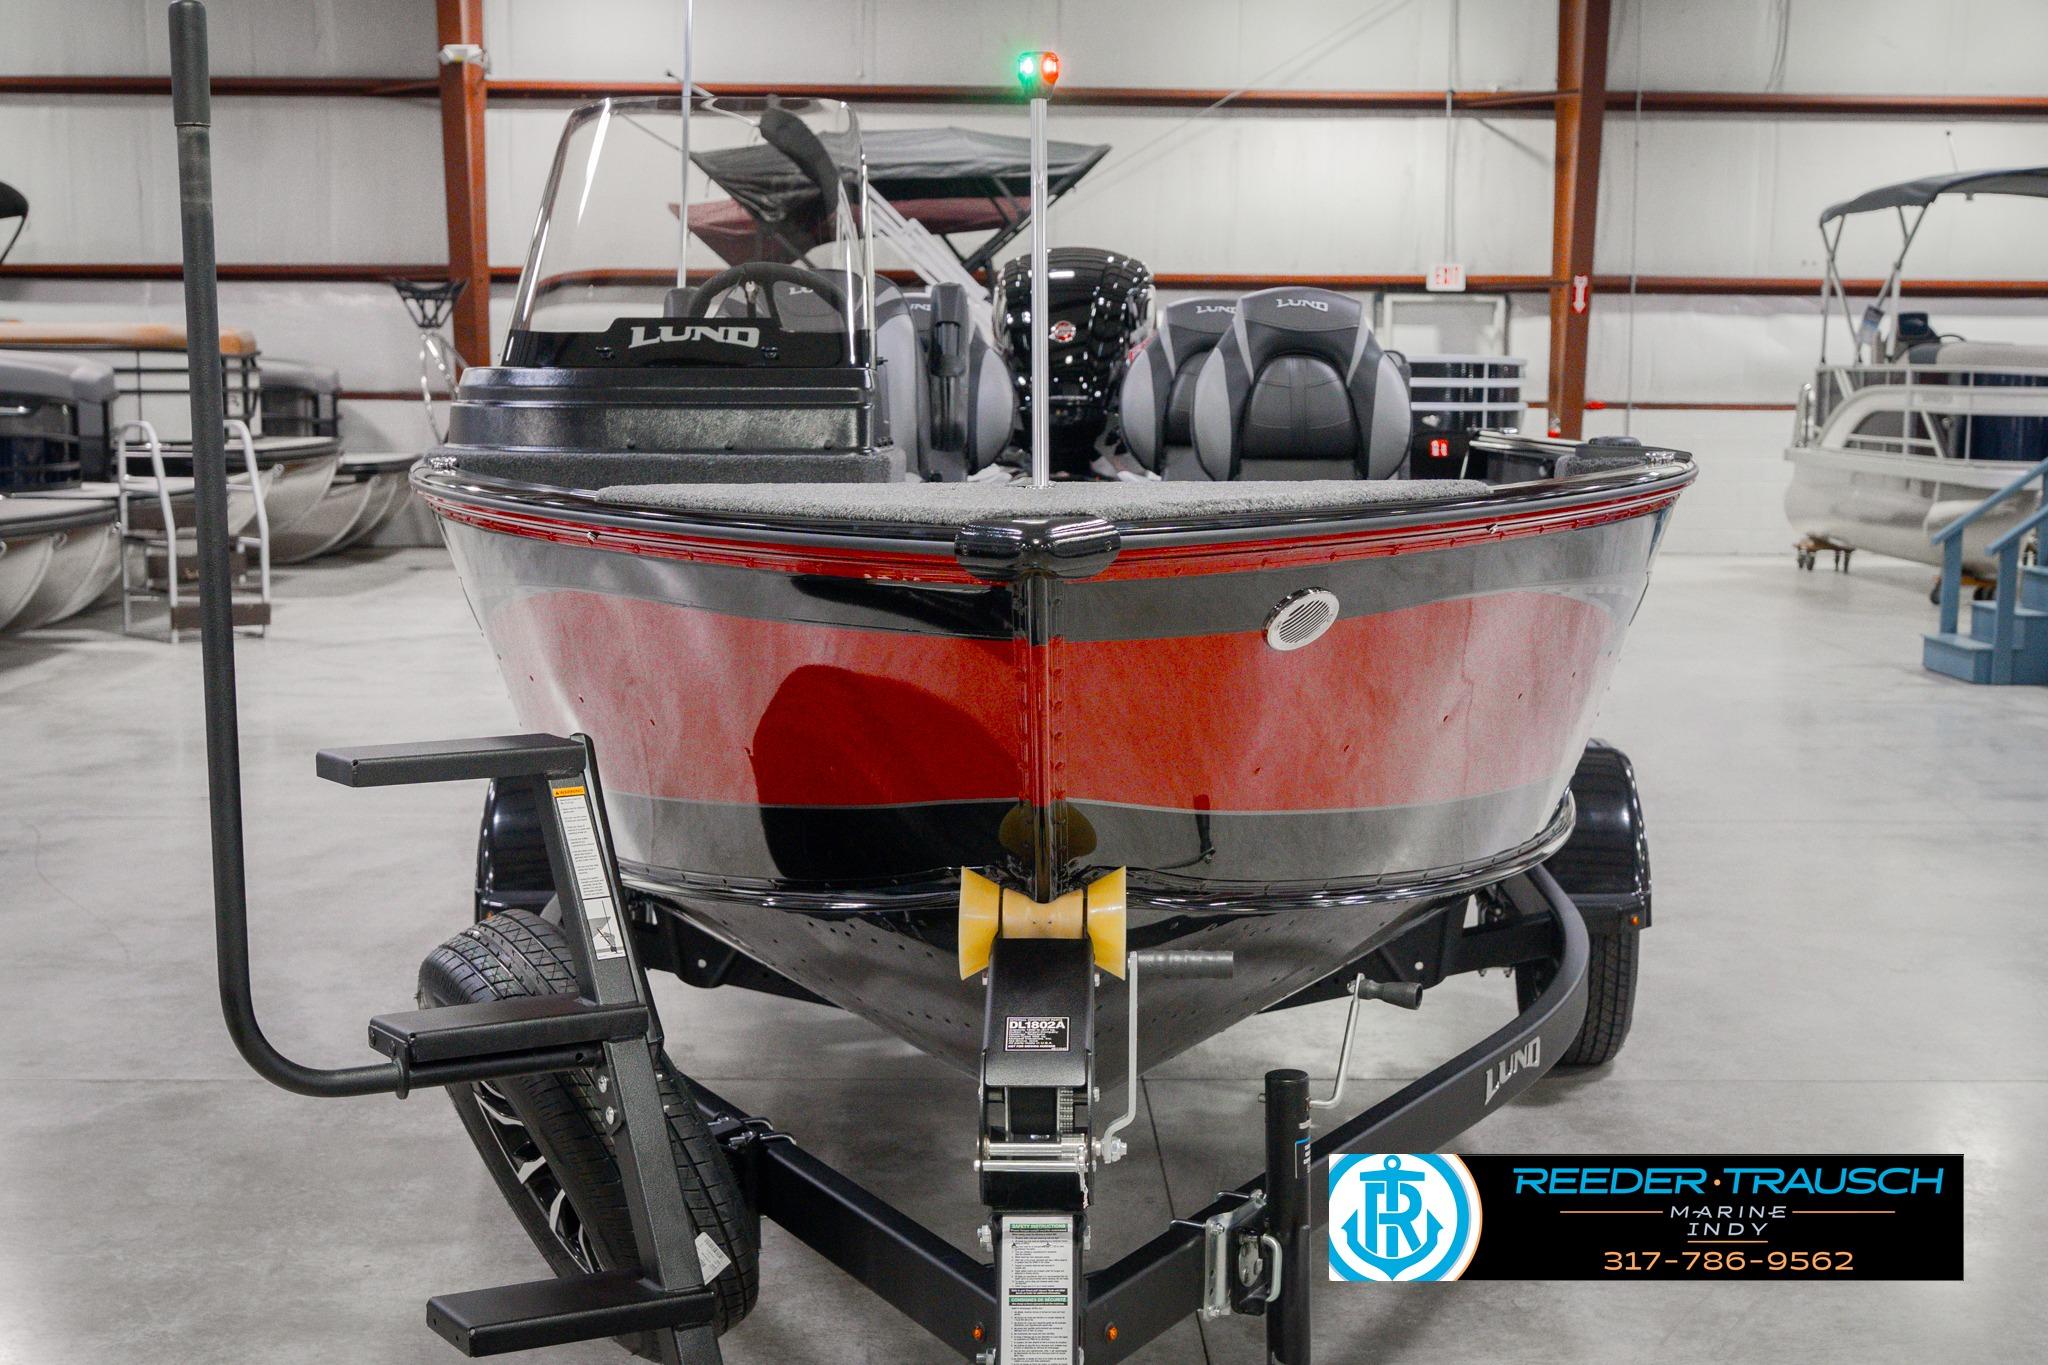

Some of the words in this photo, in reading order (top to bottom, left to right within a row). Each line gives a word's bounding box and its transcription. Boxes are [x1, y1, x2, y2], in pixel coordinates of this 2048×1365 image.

[1277, 298, 1329, 312] LUND
[628, 326, 760, 349] LUND
[1009, 1021, 1065, 1029] DL1802A
[1484, 1036, 1541, 1106] LUND
